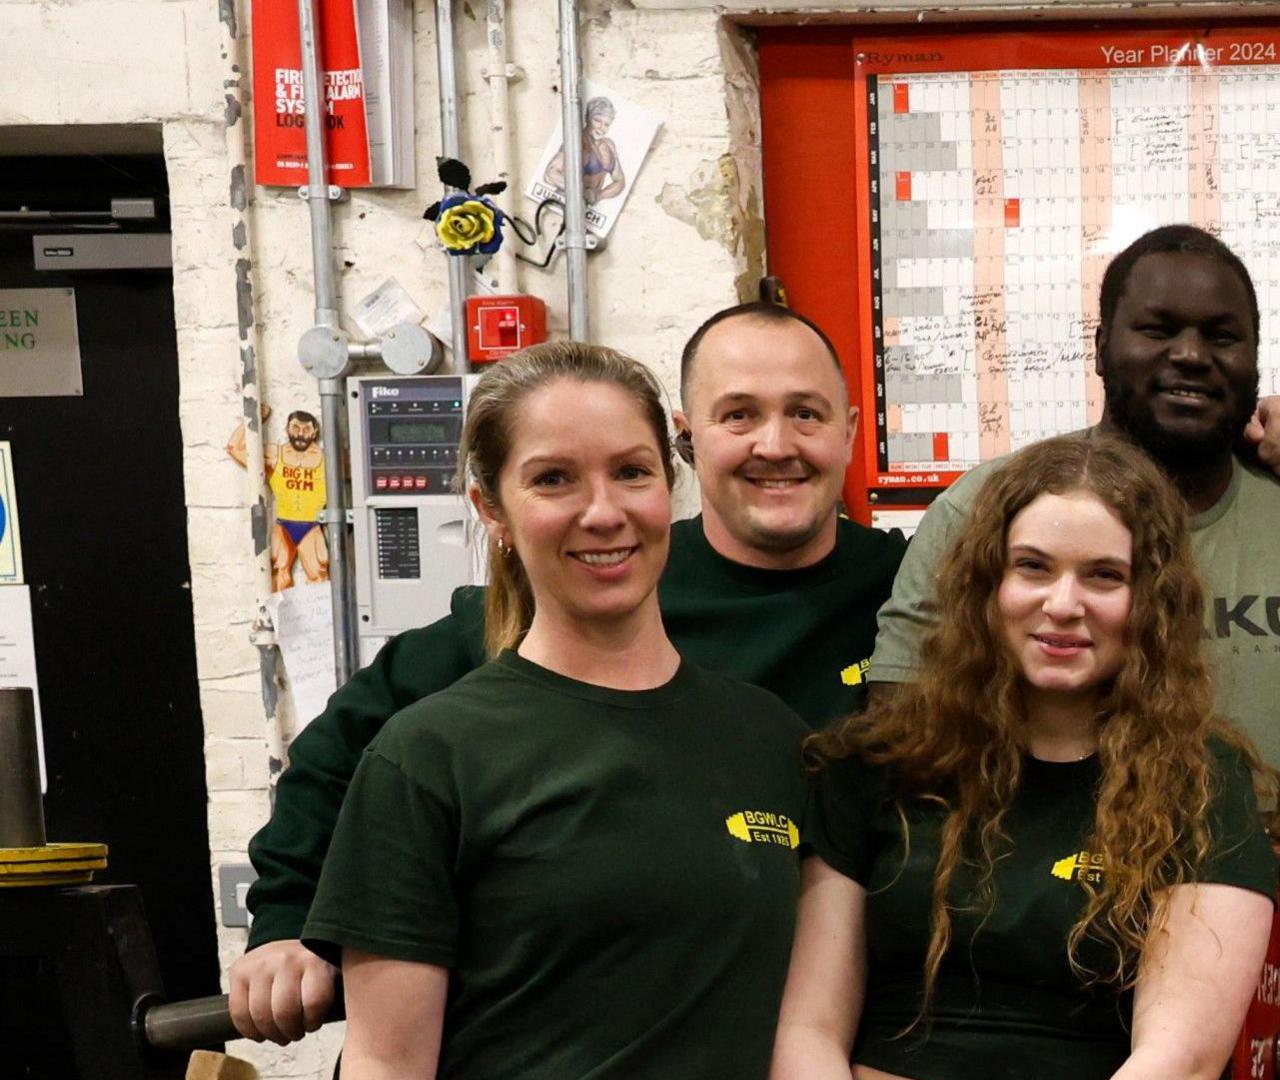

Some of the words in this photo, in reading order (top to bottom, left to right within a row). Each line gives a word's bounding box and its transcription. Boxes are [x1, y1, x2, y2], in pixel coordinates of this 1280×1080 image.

[868, 51, 943, 62] Ryman
[1100, 46, 1144, 63] Year
[1151, 43, 1224, 62] Planner
[1229, 42, 1276, 61] 2024
[275, 68, 304, 84] FIR
[275, 84, 287, 99] &
[282, 466, 301, 480] BIG
[878, 474, 939, 484] ryman.co.uk
[286, 479, 313, 492] GYM
[744, 810, 788, 829] BGWLC
[1077, 869, 1102, 883] Est
